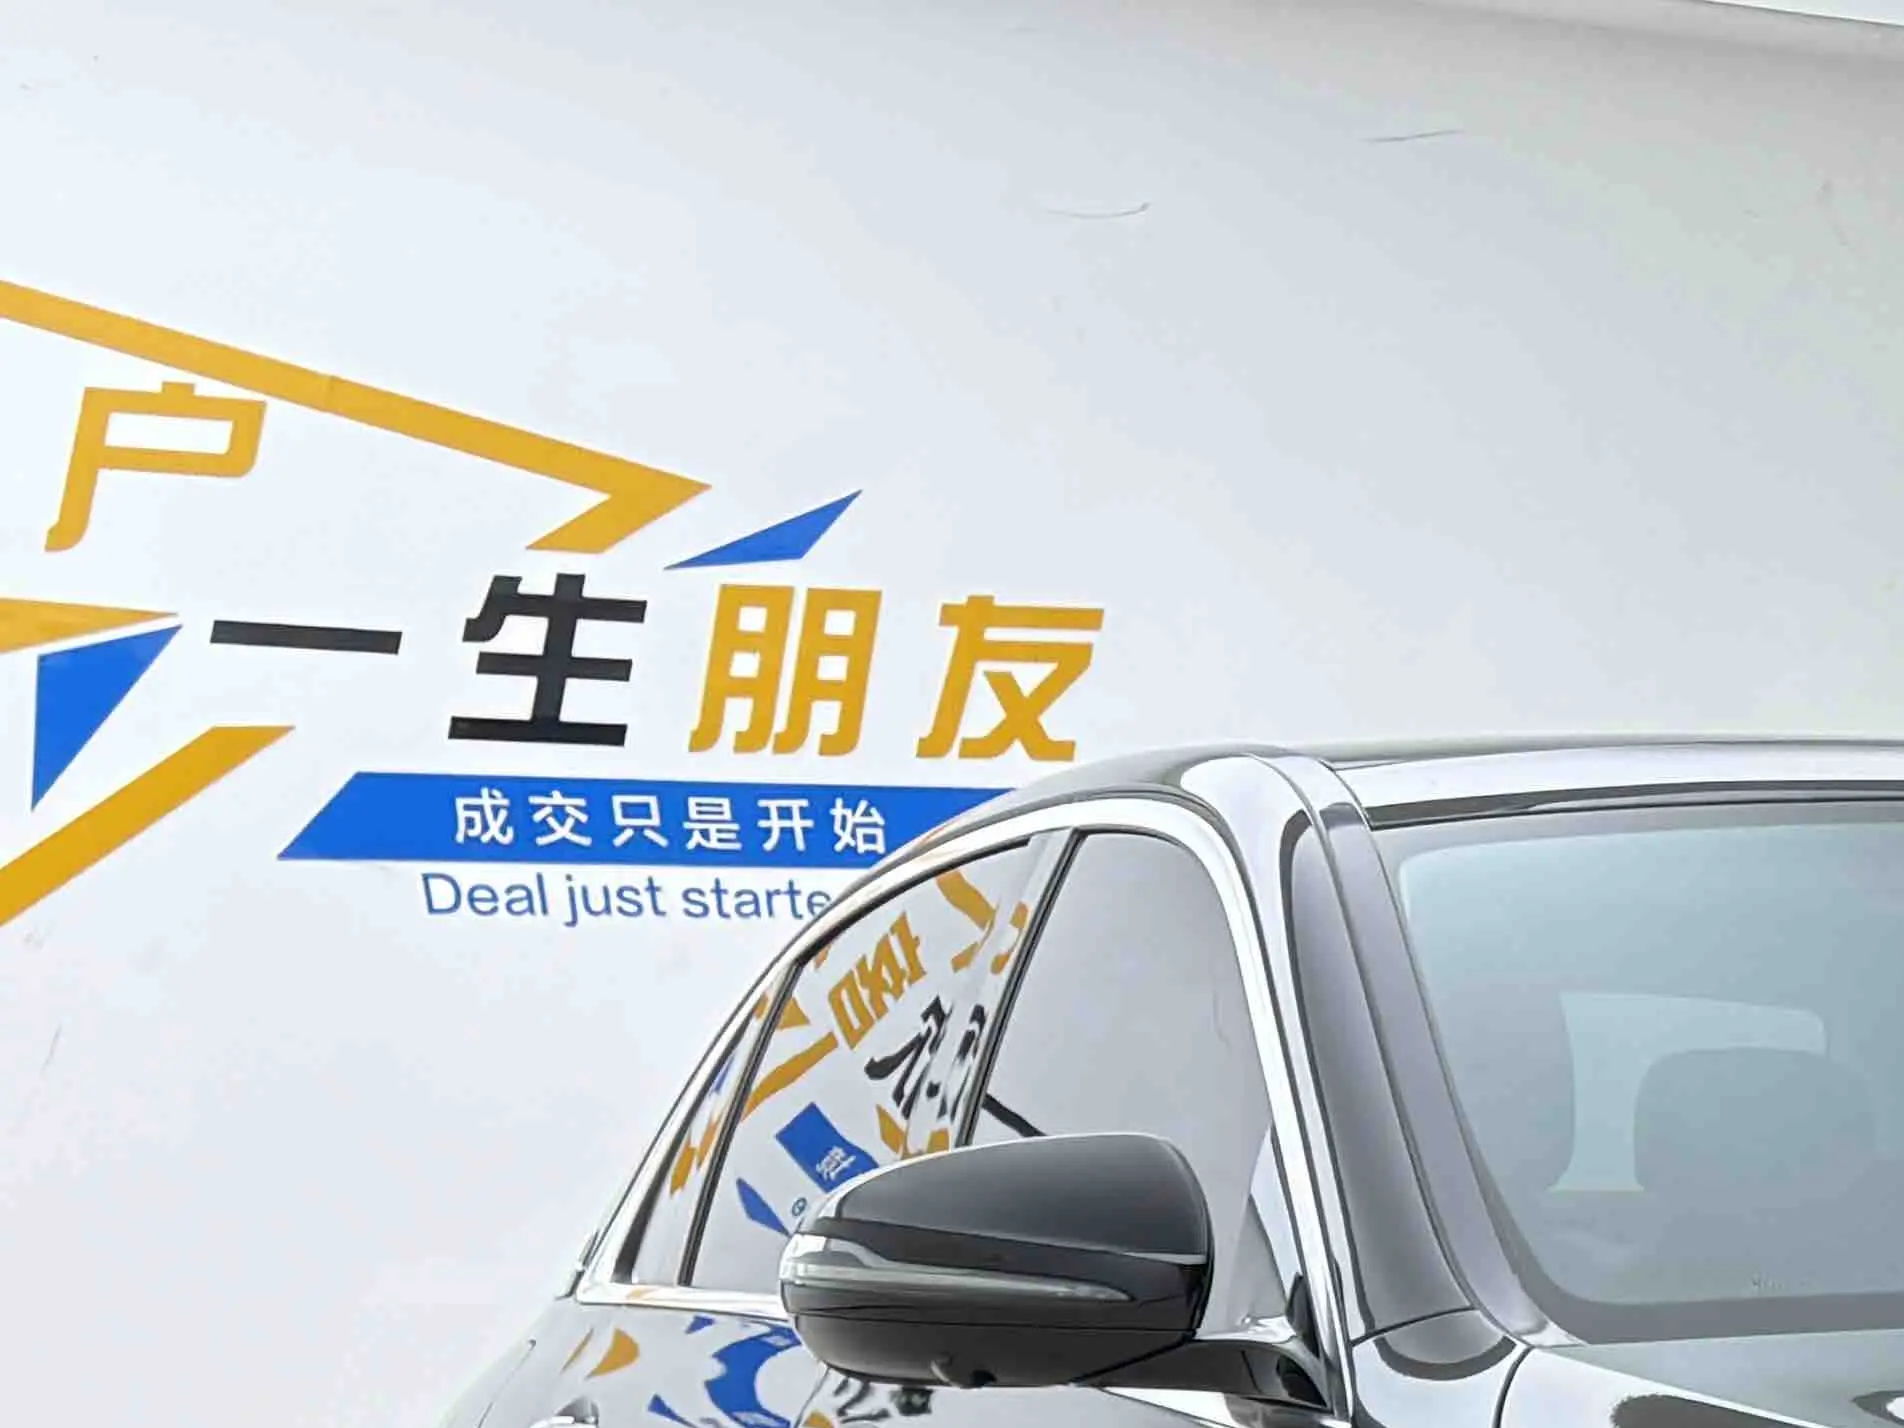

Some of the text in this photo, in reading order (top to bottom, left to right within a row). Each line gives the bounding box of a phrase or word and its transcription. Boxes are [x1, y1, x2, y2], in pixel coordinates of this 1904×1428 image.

[46, 381, 267, 553] 户
[209, 573, 1104, 763] 一生朋友
[454, 787, 887, 855] 成交只是开始
[421, 872, 833, 928] Deal just starte
